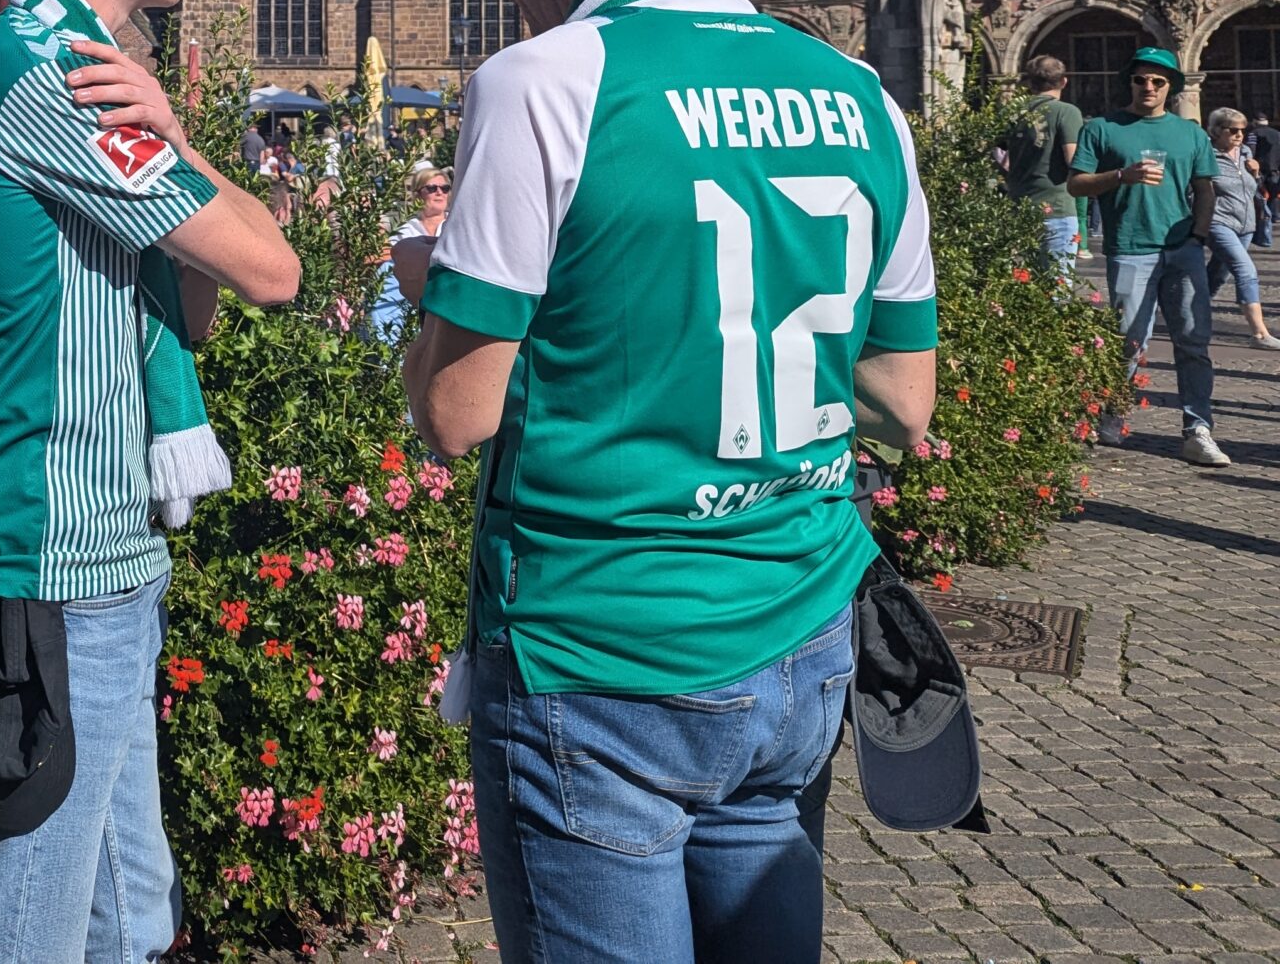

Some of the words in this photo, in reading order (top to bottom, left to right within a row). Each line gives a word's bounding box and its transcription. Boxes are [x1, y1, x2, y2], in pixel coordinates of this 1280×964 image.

[665, 87, 871, 151] WERDER
[131, 151, 174, 189] BUNDESLIGA
[693, 175, 873, 459] 12
